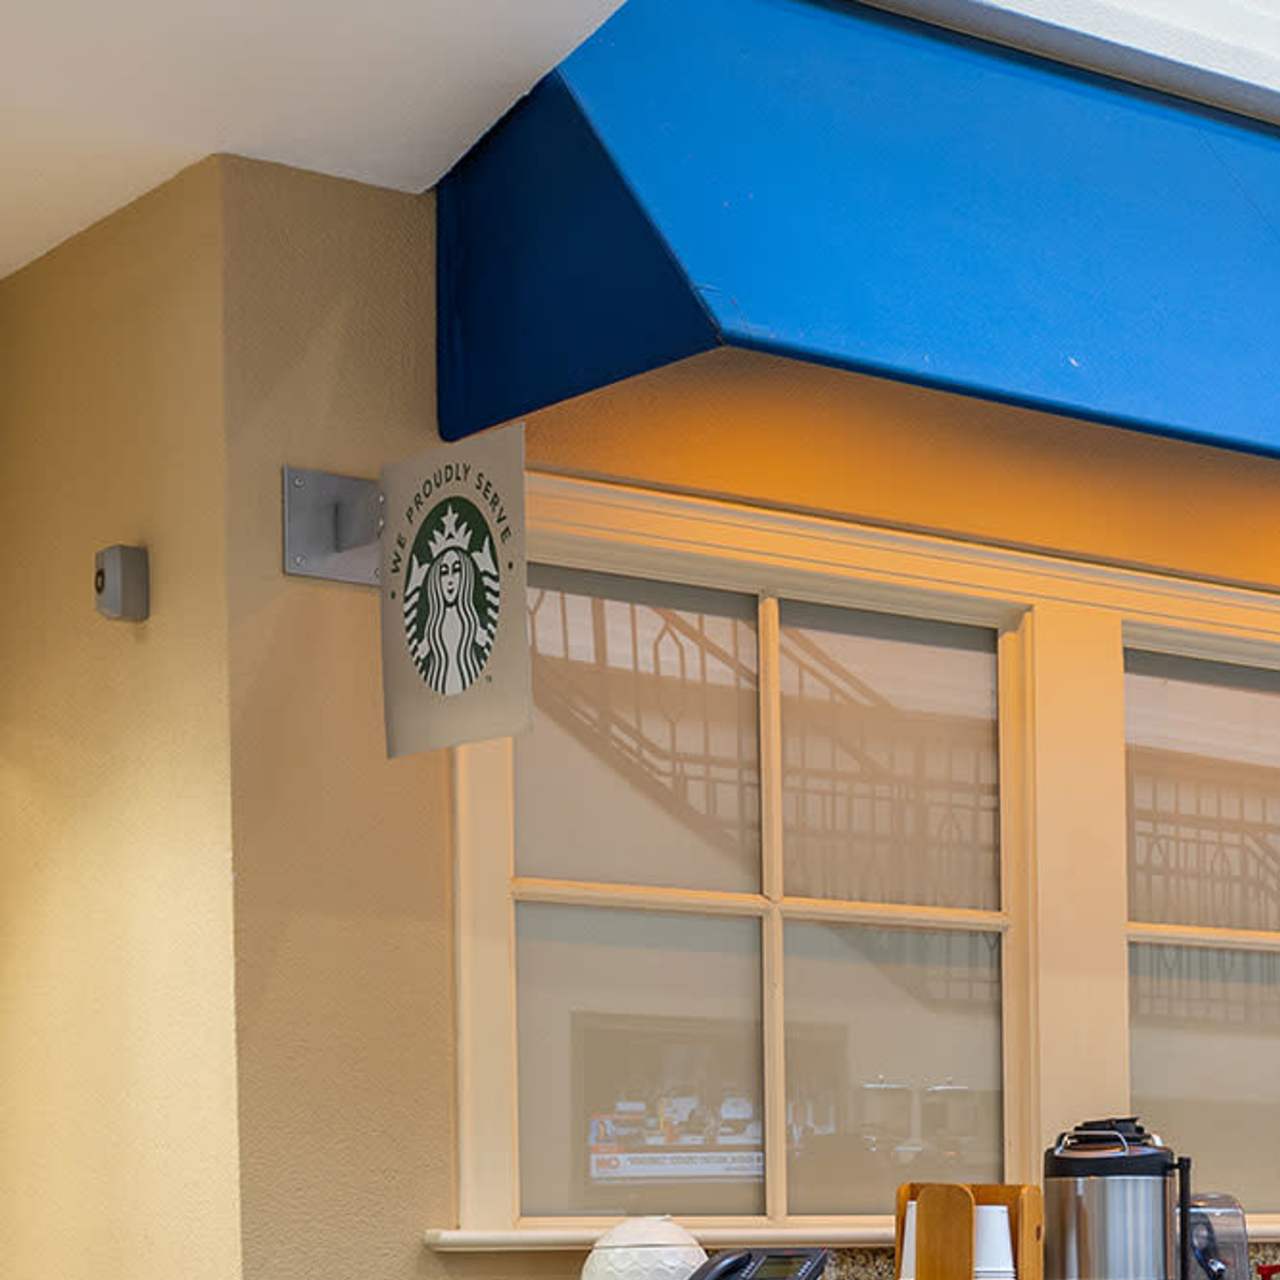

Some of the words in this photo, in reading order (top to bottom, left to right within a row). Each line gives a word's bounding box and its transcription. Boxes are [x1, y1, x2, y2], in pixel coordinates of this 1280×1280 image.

[391, 533, 407, 573] WE
[406, 463, 471, 524] PROUDLY
[475, 472, 511, 544] SERVE
